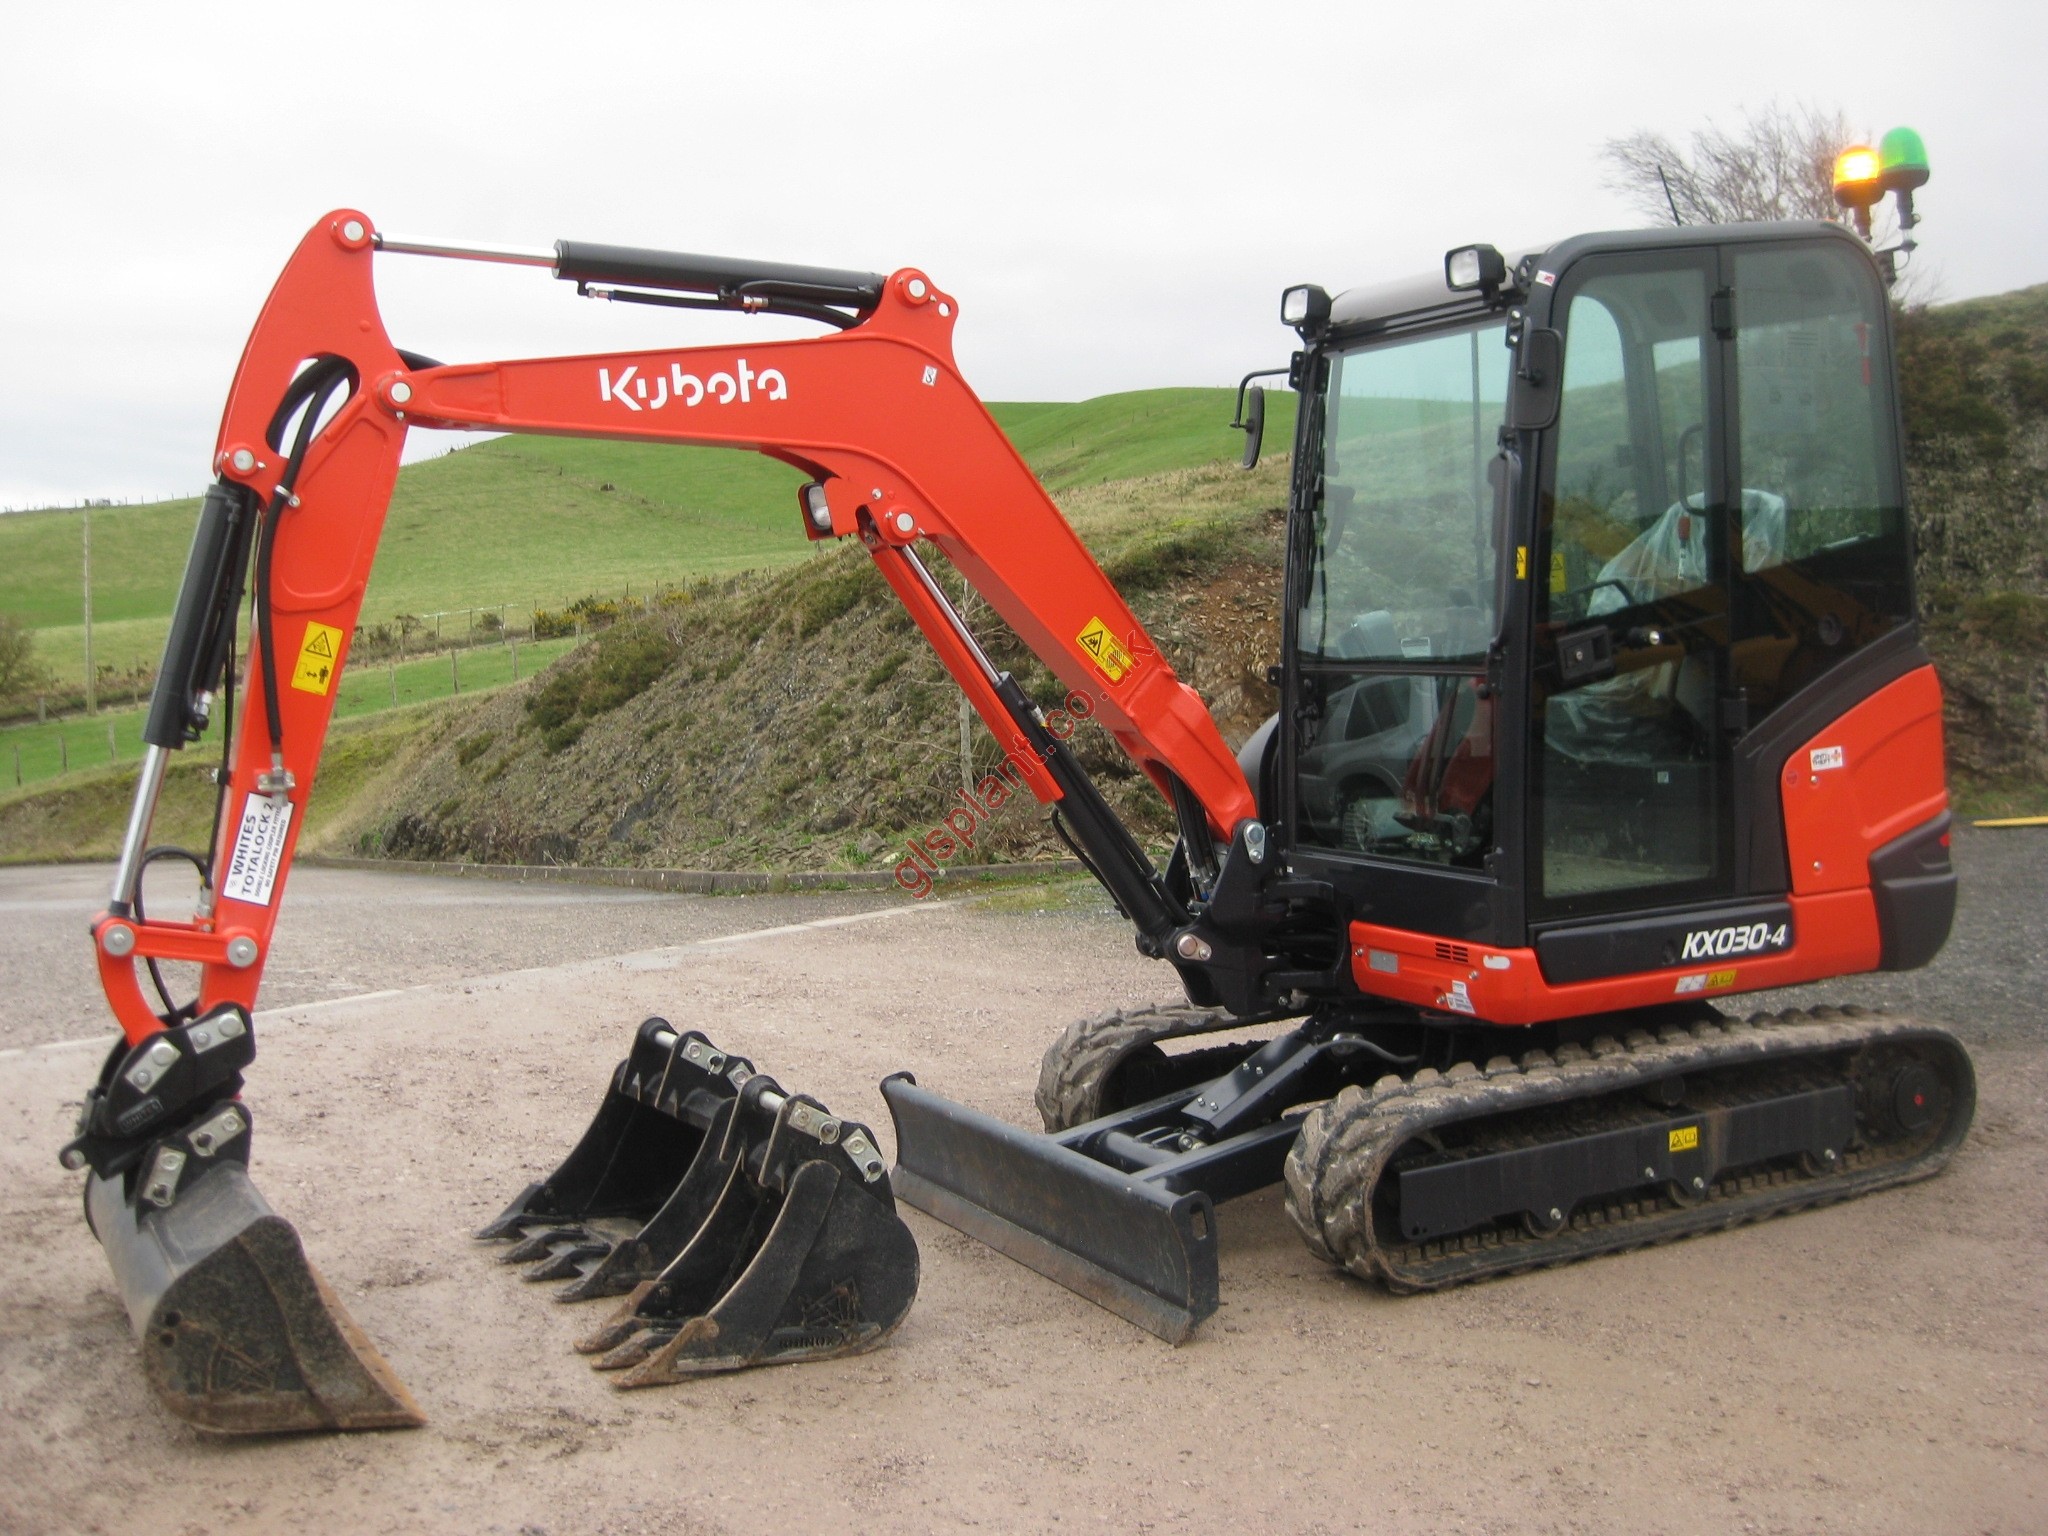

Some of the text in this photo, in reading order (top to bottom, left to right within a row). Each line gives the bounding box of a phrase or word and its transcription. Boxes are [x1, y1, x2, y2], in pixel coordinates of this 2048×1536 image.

[598, 358, 788, 412] Kubota
[232, 814, 256, 875] WHITES
[241, 801, 273, 893] TOTALOCK 2
[260, 850, 270, 874] LOCKING
[266, 825, 276, 850] COUPLER
[266, 857, 276, 877] SAFETY
[275, 819, 286, 846] REQUIRED
[1681, 922, 1787, 959] KX030-4
